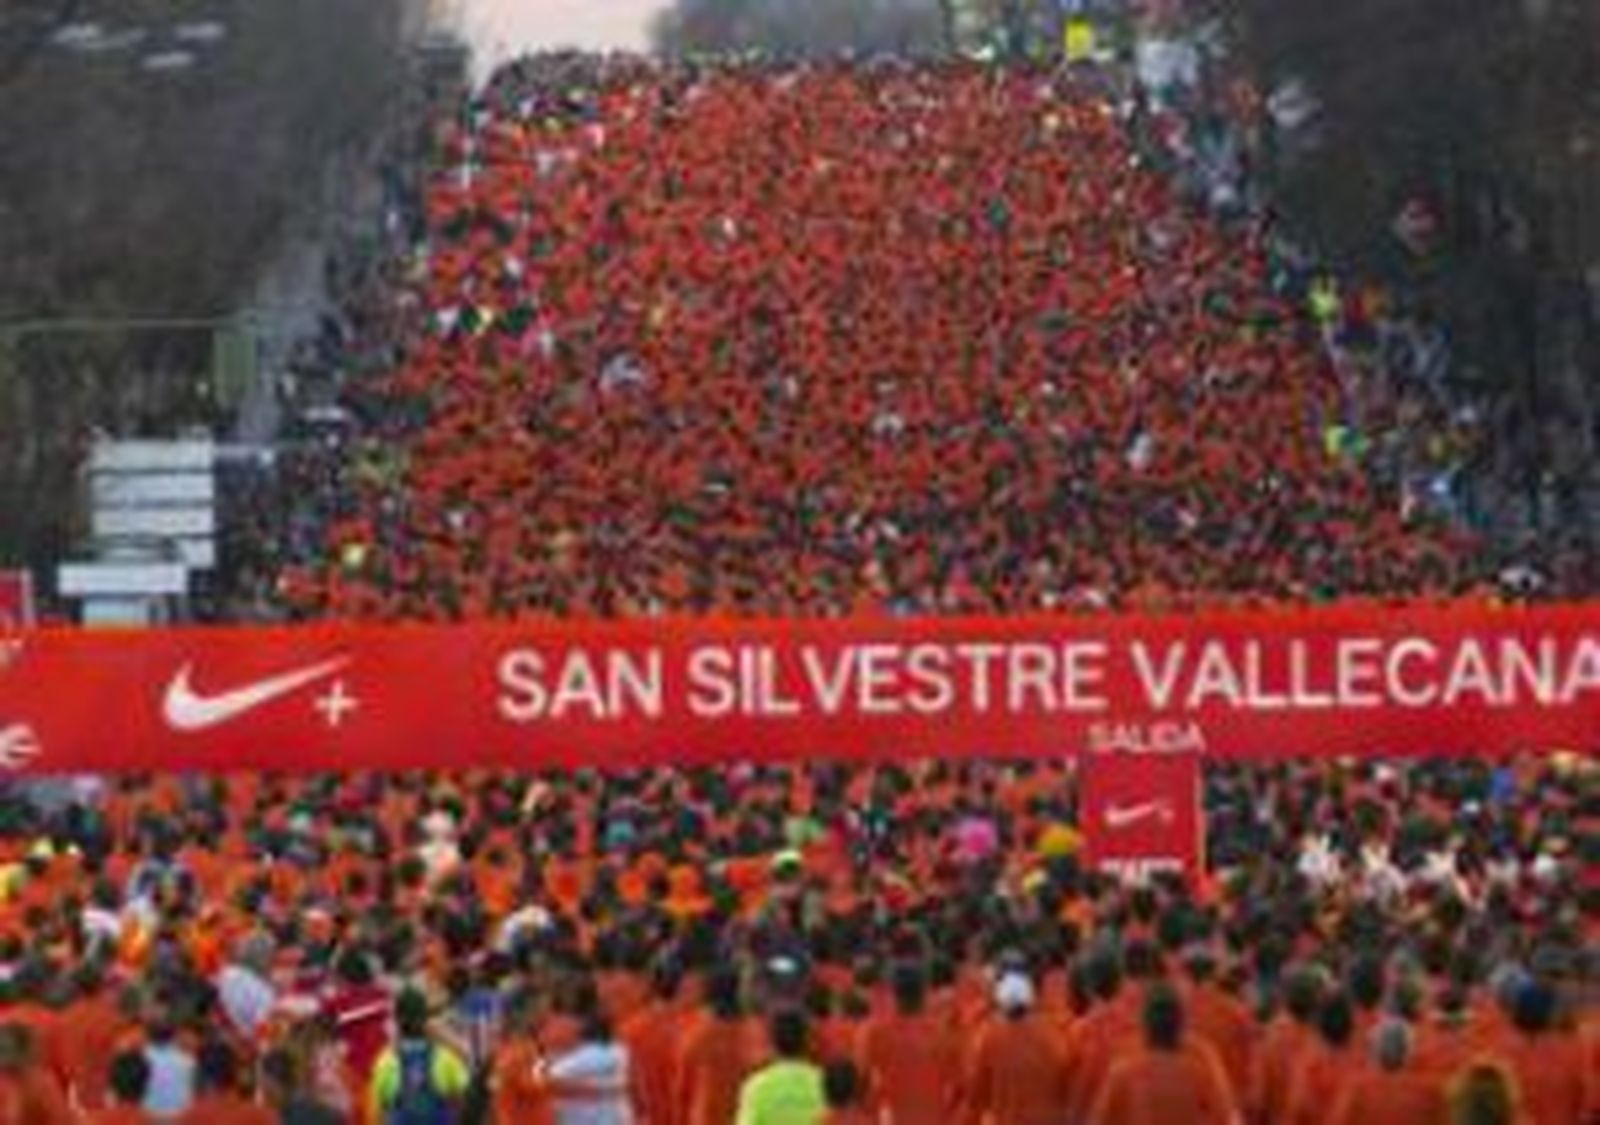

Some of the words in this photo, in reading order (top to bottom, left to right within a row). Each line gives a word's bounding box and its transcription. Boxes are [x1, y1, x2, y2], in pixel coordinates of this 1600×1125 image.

[498, 648, 662, 717] SAN
[687, 643, 1108, 714] SILVESTRE
[1132, 638, 1600, 707] VALLECANA
